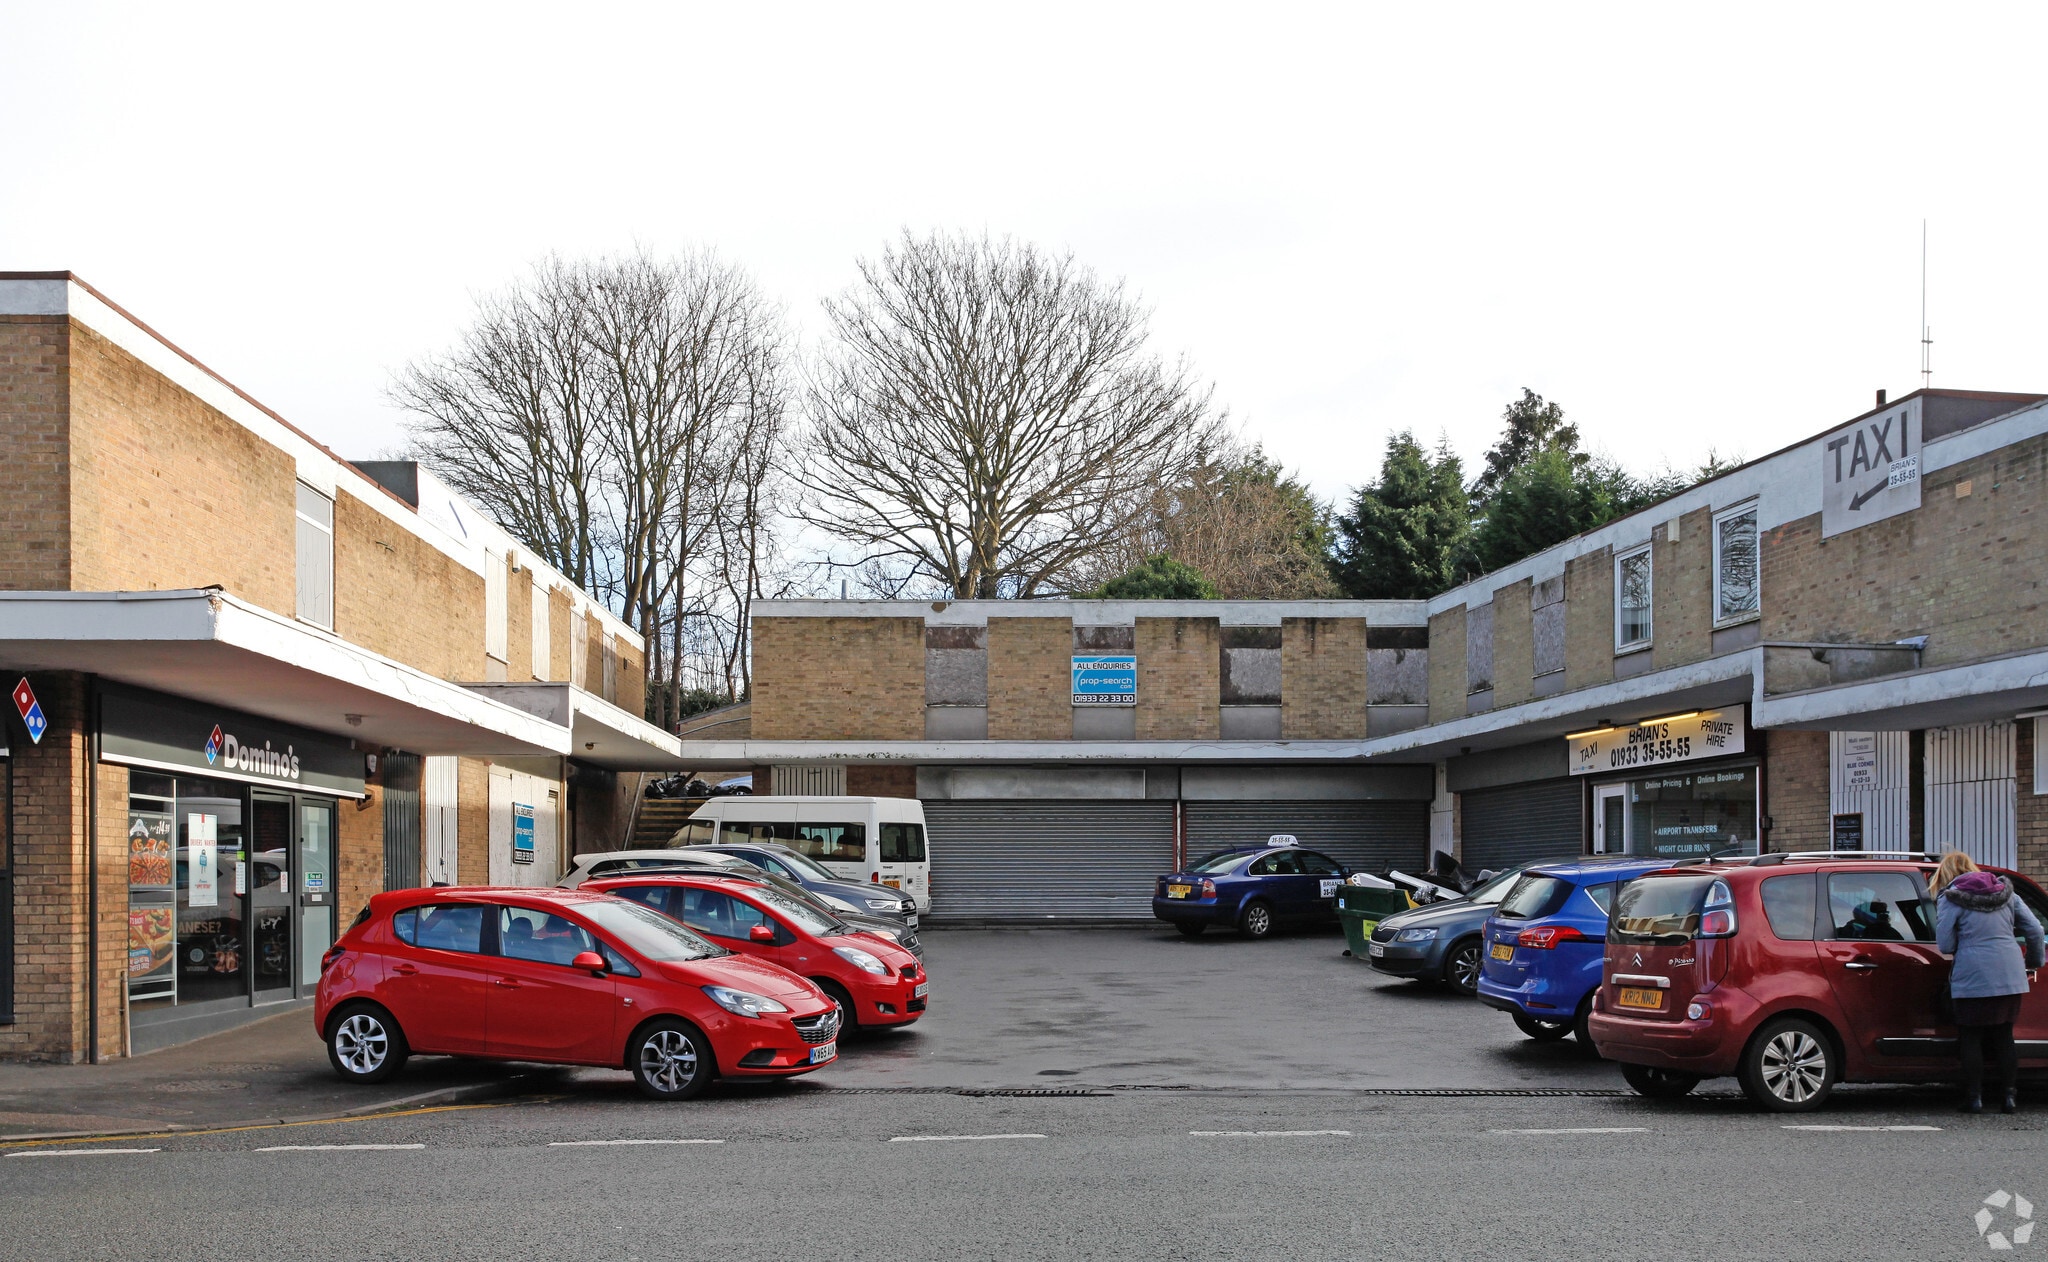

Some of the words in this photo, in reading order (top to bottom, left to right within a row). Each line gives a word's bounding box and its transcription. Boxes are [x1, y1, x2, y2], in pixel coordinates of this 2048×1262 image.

[1827, 410, 1908, 484] TAXI
[1890, 456, 1917, 473] BRIAN'S
[1890, 468, 1916, 486] 35-55-55
[1080, 678, 1133, 686] prop-search
[1074, 694, 1098, 702] 01933
[1098, 694, 1109, 702] 22
[1110, 694, 1121, 702] 33
[1122, 694, 1134, 702] 00
[1628, 723, 1669, 744] BRIAN'S
[1700, 719, 1734, 736] PRIVATE
[1705, 733, 1726, 748] HIRE
[224, 733, 300, 779] Domino's
[1580, 741, 1598, 763] TAXI
[1610, 745, 1638, 768] 01933
[1642, 736, 1690, 763] 35-55-55
[1645, 781, 1662, 790] Online
[1662, 779, 1682, 789] Pricing
[1697, 775, 1716, 785] Online
[1716, 771, 1745, 782] Bookings
[1657, 826, 1682, 836] AIRPORT
[1683, 824, 1718, 835] TRANSFERS
[1658, 844, 1676, 854] NIGHT
[1677, 844, 1693, 853] CLUB
[1693, 843, 1711, 852] RUNS
[177, 921, 222, 935] ANESE?
